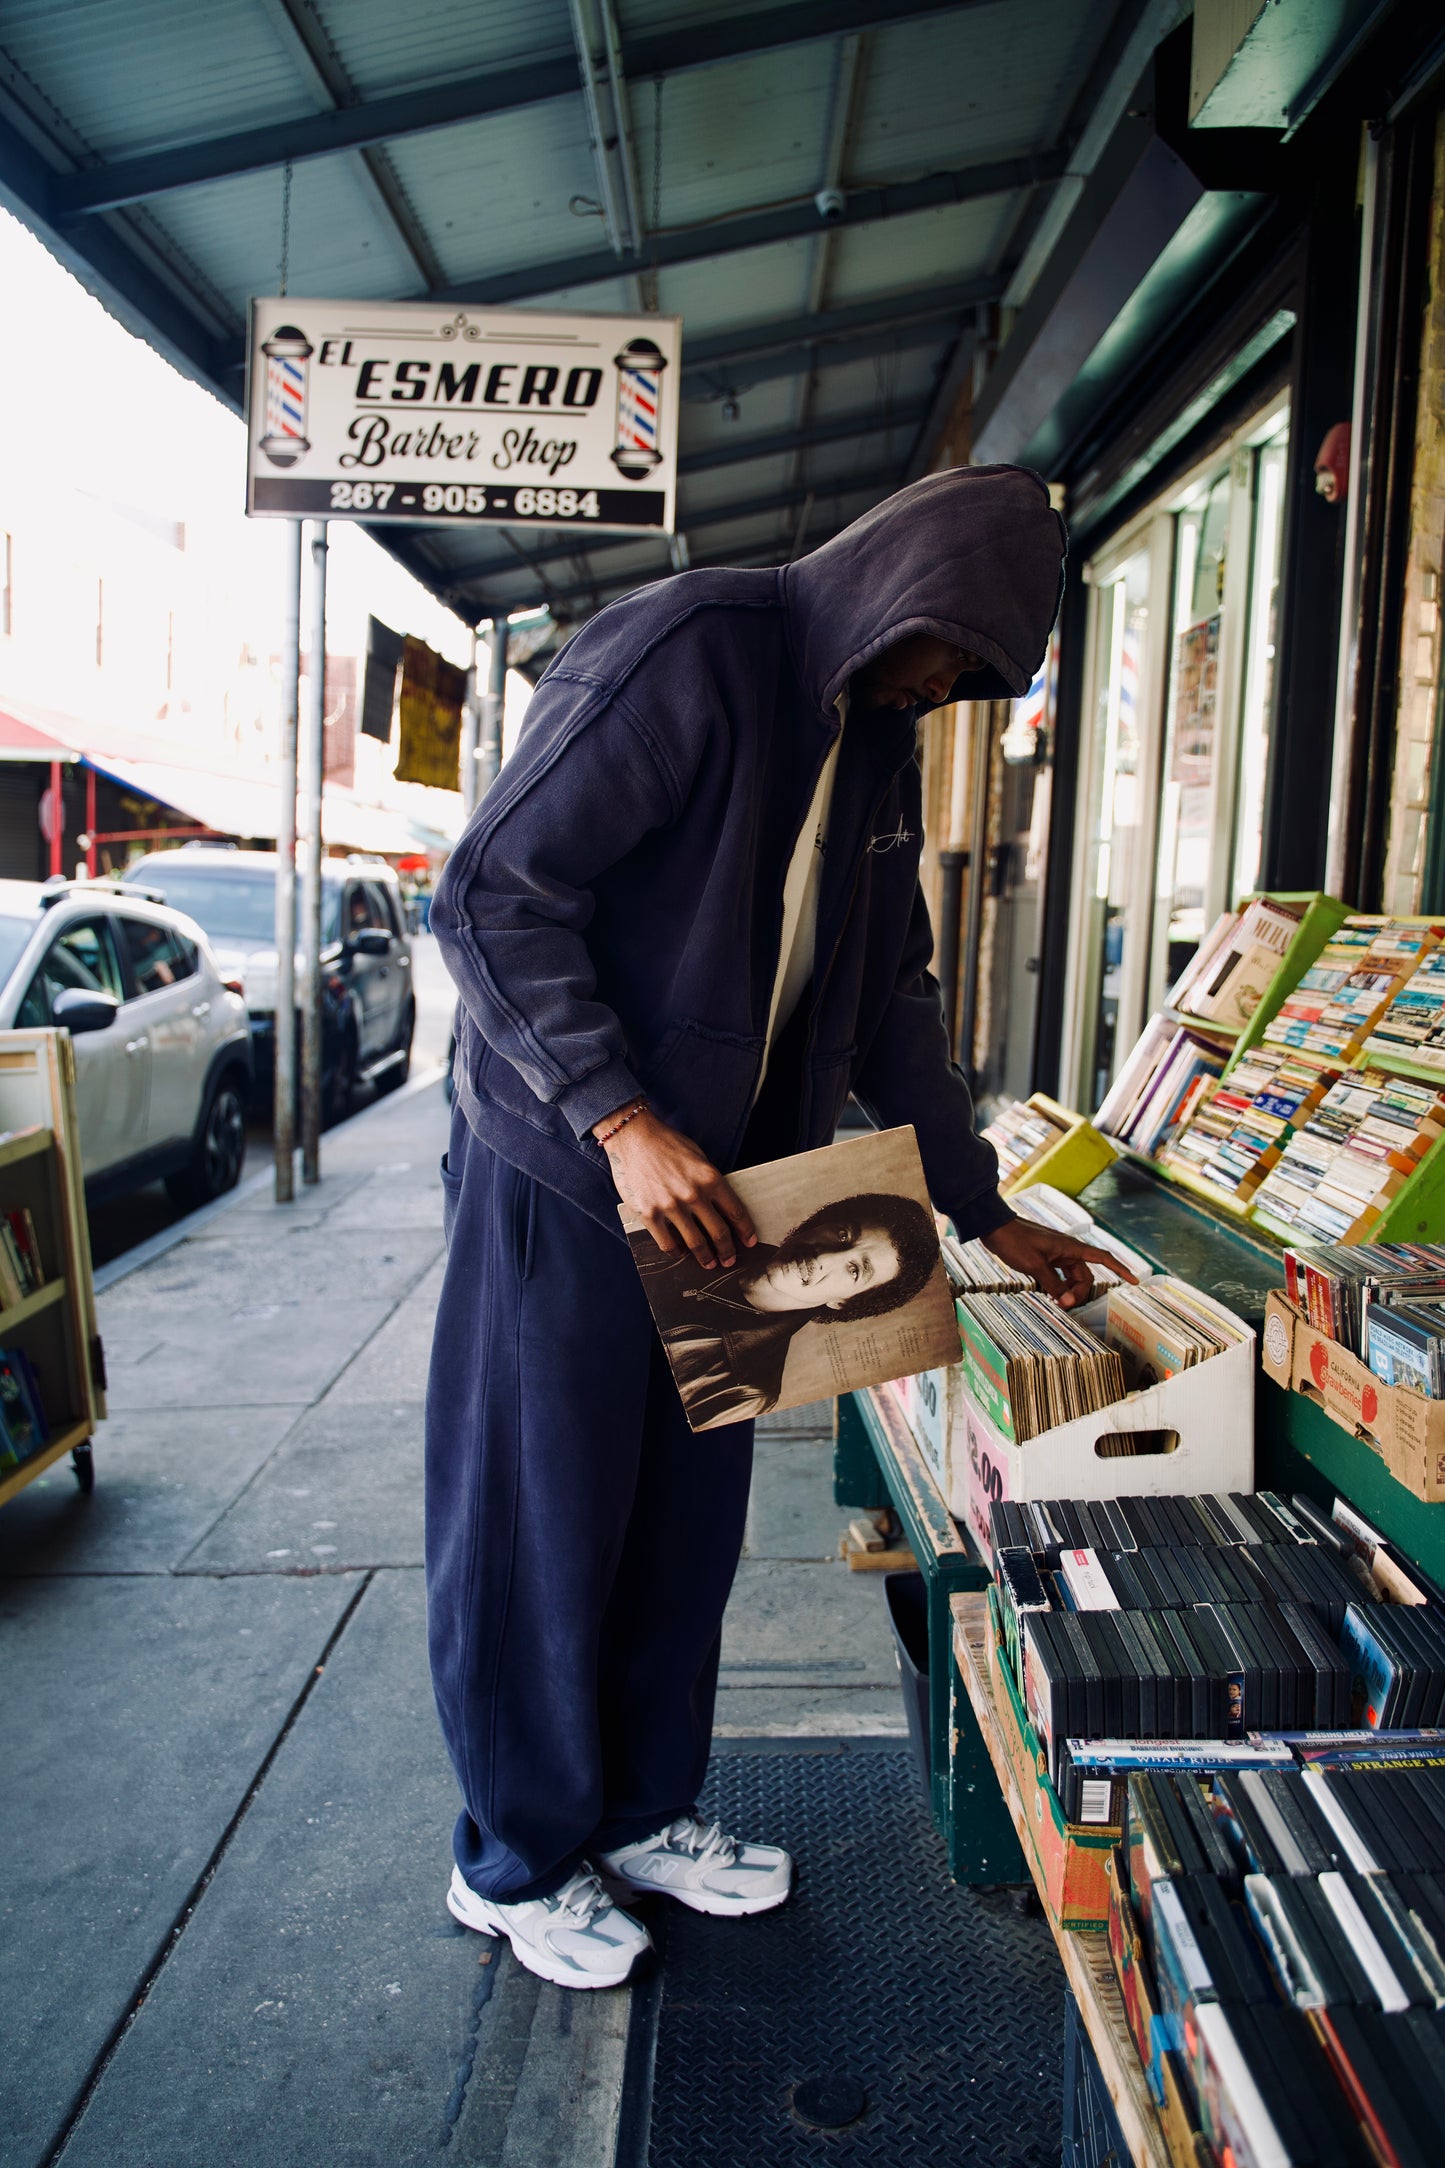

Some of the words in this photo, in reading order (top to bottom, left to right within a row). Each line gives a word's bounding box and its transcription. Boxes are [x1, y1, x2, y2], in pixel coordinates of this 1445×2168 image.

[319, 340, 357, 366] EL
[356, 360, 604, 407] ESMERO
[339, 414, 481, 468] Barber
[493, 427, 578, 476] Shop
[330, 482, 395, 509] 267
[423, 486, 486, 512] 905
[514, 489, 600, 517] 6884
[1320, 1366, 1362, 1412] Strawberries
[1330, 1361, 1361, 1391] CALIFORNIA
[1305, 1731, 1343, 1739] RAISING
[1344, 1731, 1375, 1739] HELEN
[1137, 1756, 1188, 1764] WHALE
[1351, 1759, 1425, 1771] STRANGE
